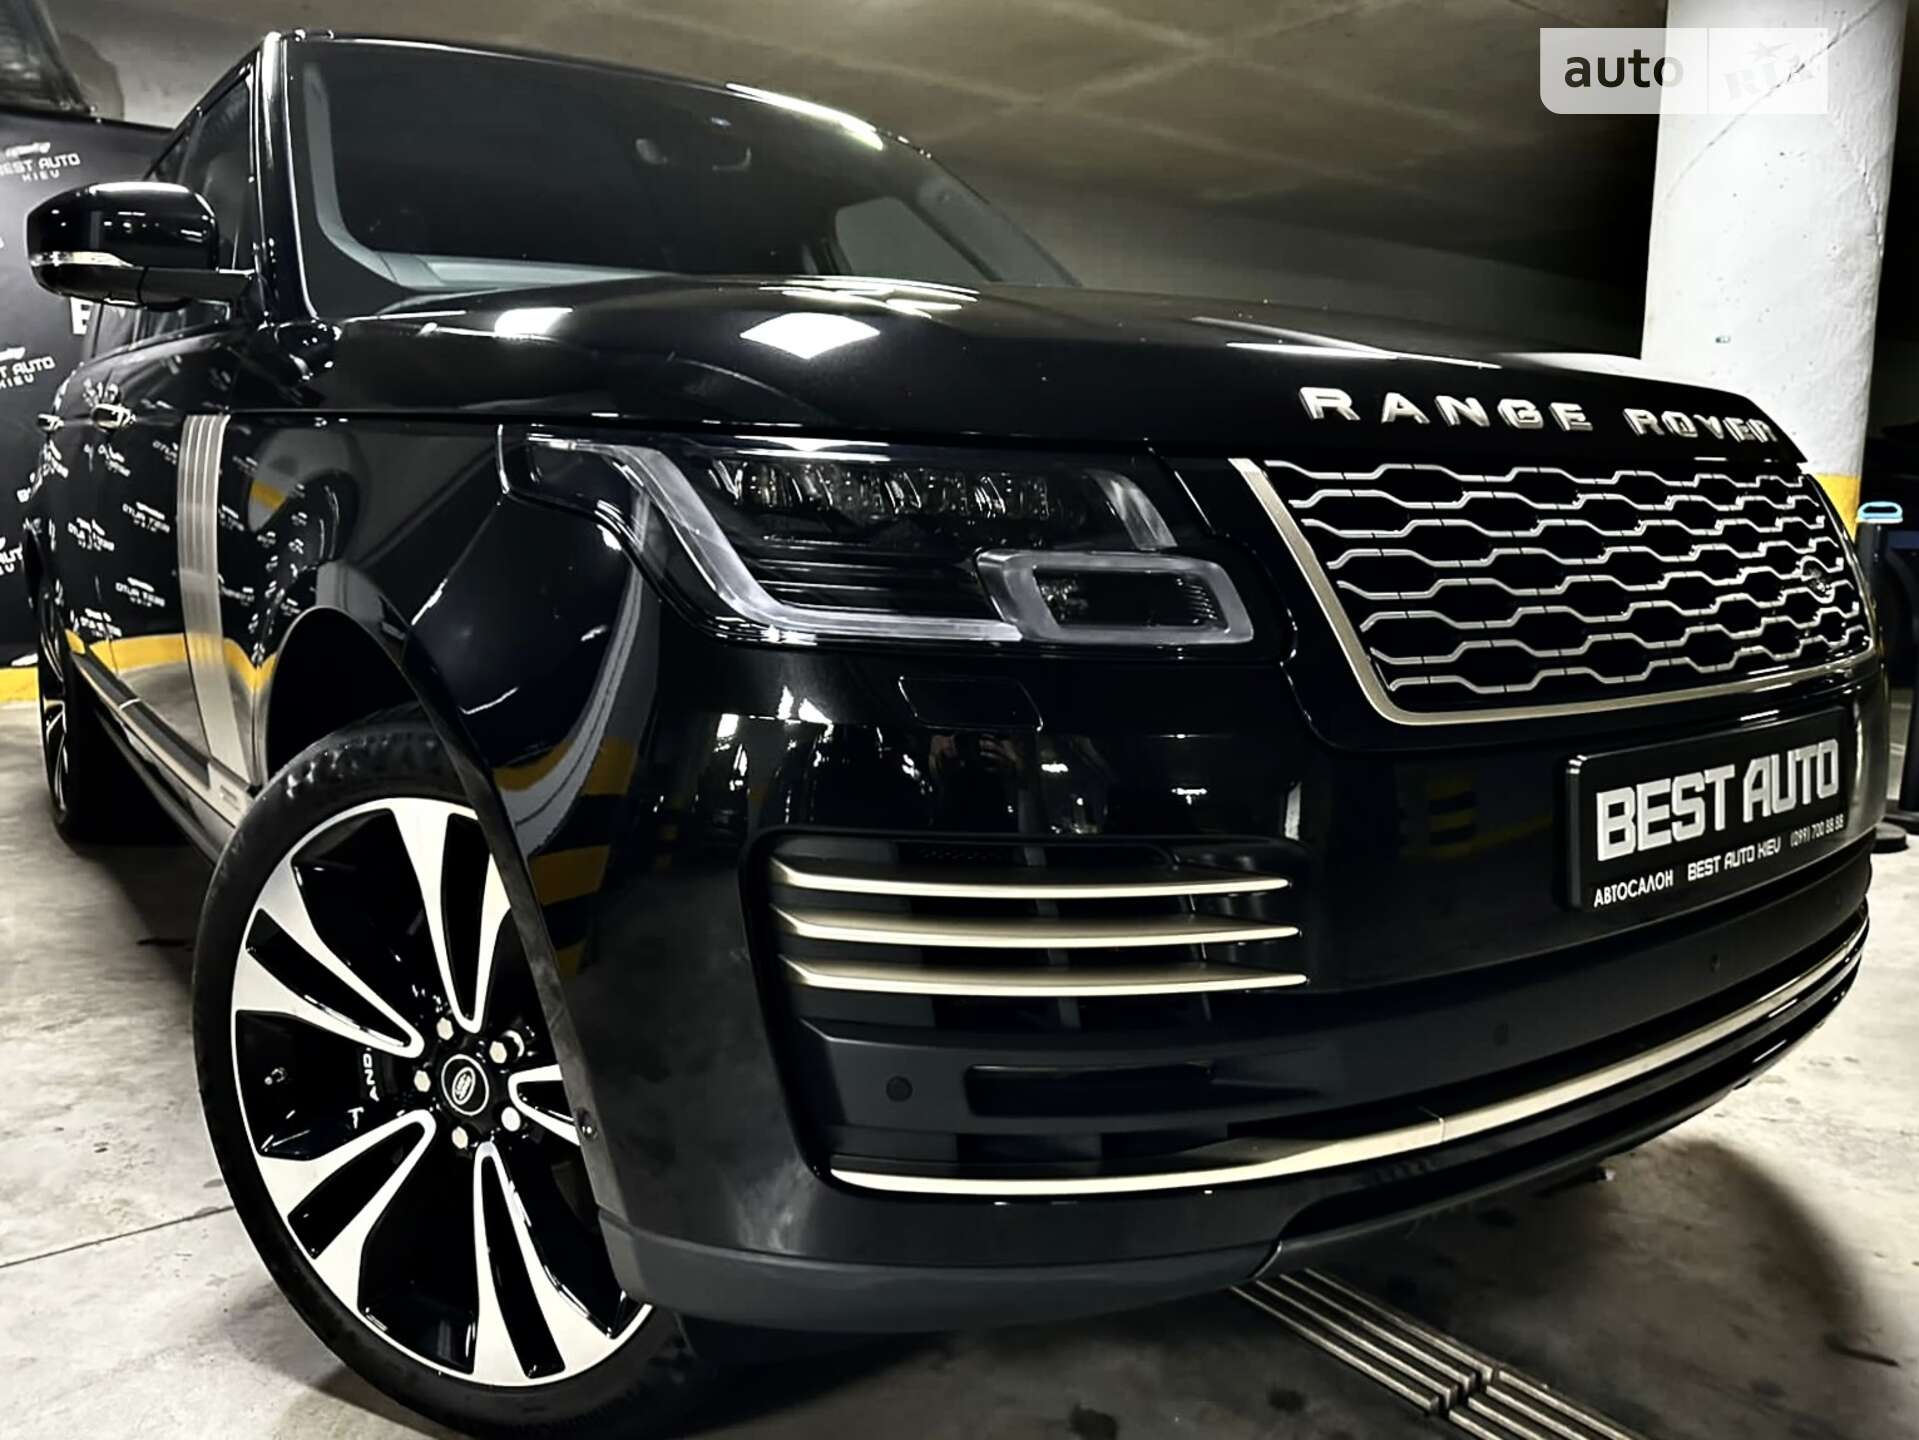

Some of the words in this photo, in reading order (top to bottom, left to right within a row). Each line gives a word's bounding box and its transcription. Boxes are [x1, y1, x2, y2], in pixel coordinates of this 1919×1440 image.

[22, 169, 60, 182] KIEV
[38, 153, 81, 170] AUTO
[12, 356, 56, 376] AUTO
[1299, 386, 1594, 432] RANGE
[1622, 408, 1779, 443] ROVER
[1596, 764, 1735, 862] BEST
[1743, 738, 1839, 823] AUTO
[1687, 855, 1722, 882] BEST
[1724, 844, 1755, 870] AUTO
[1757, 836, 1782, 859] KIEV
[1593, 869, 1675, 908] АВТОСАЛОН
